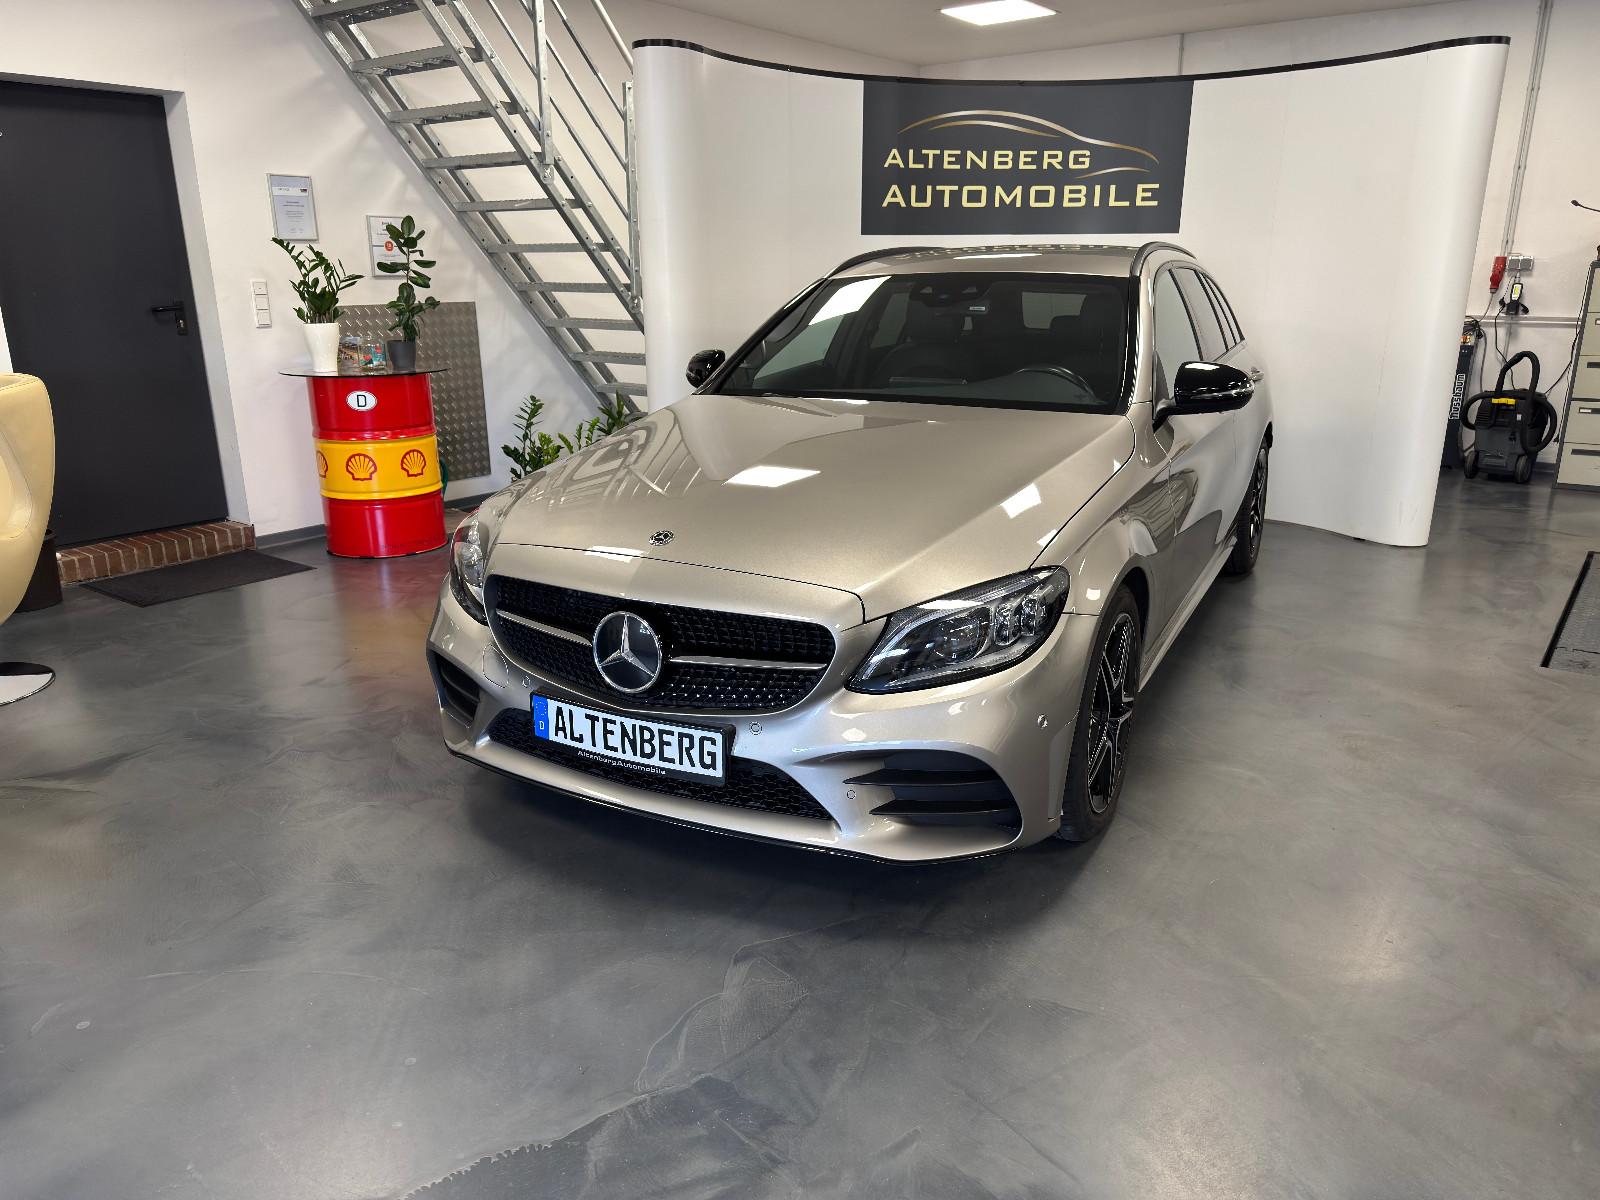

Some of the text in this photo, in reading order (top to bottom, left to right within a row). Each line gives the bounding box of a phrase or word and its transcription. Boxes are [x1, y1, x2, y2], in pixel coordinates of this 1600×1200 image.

[884, 148, 1091, 170] ALTENBERG
[882, 183, 1160, 208] AUTOMOBILE
[356, 394, 367, 408] D
[539, 720, 545, 730] D
[554, 705, 717, 771] ALTENBERG
